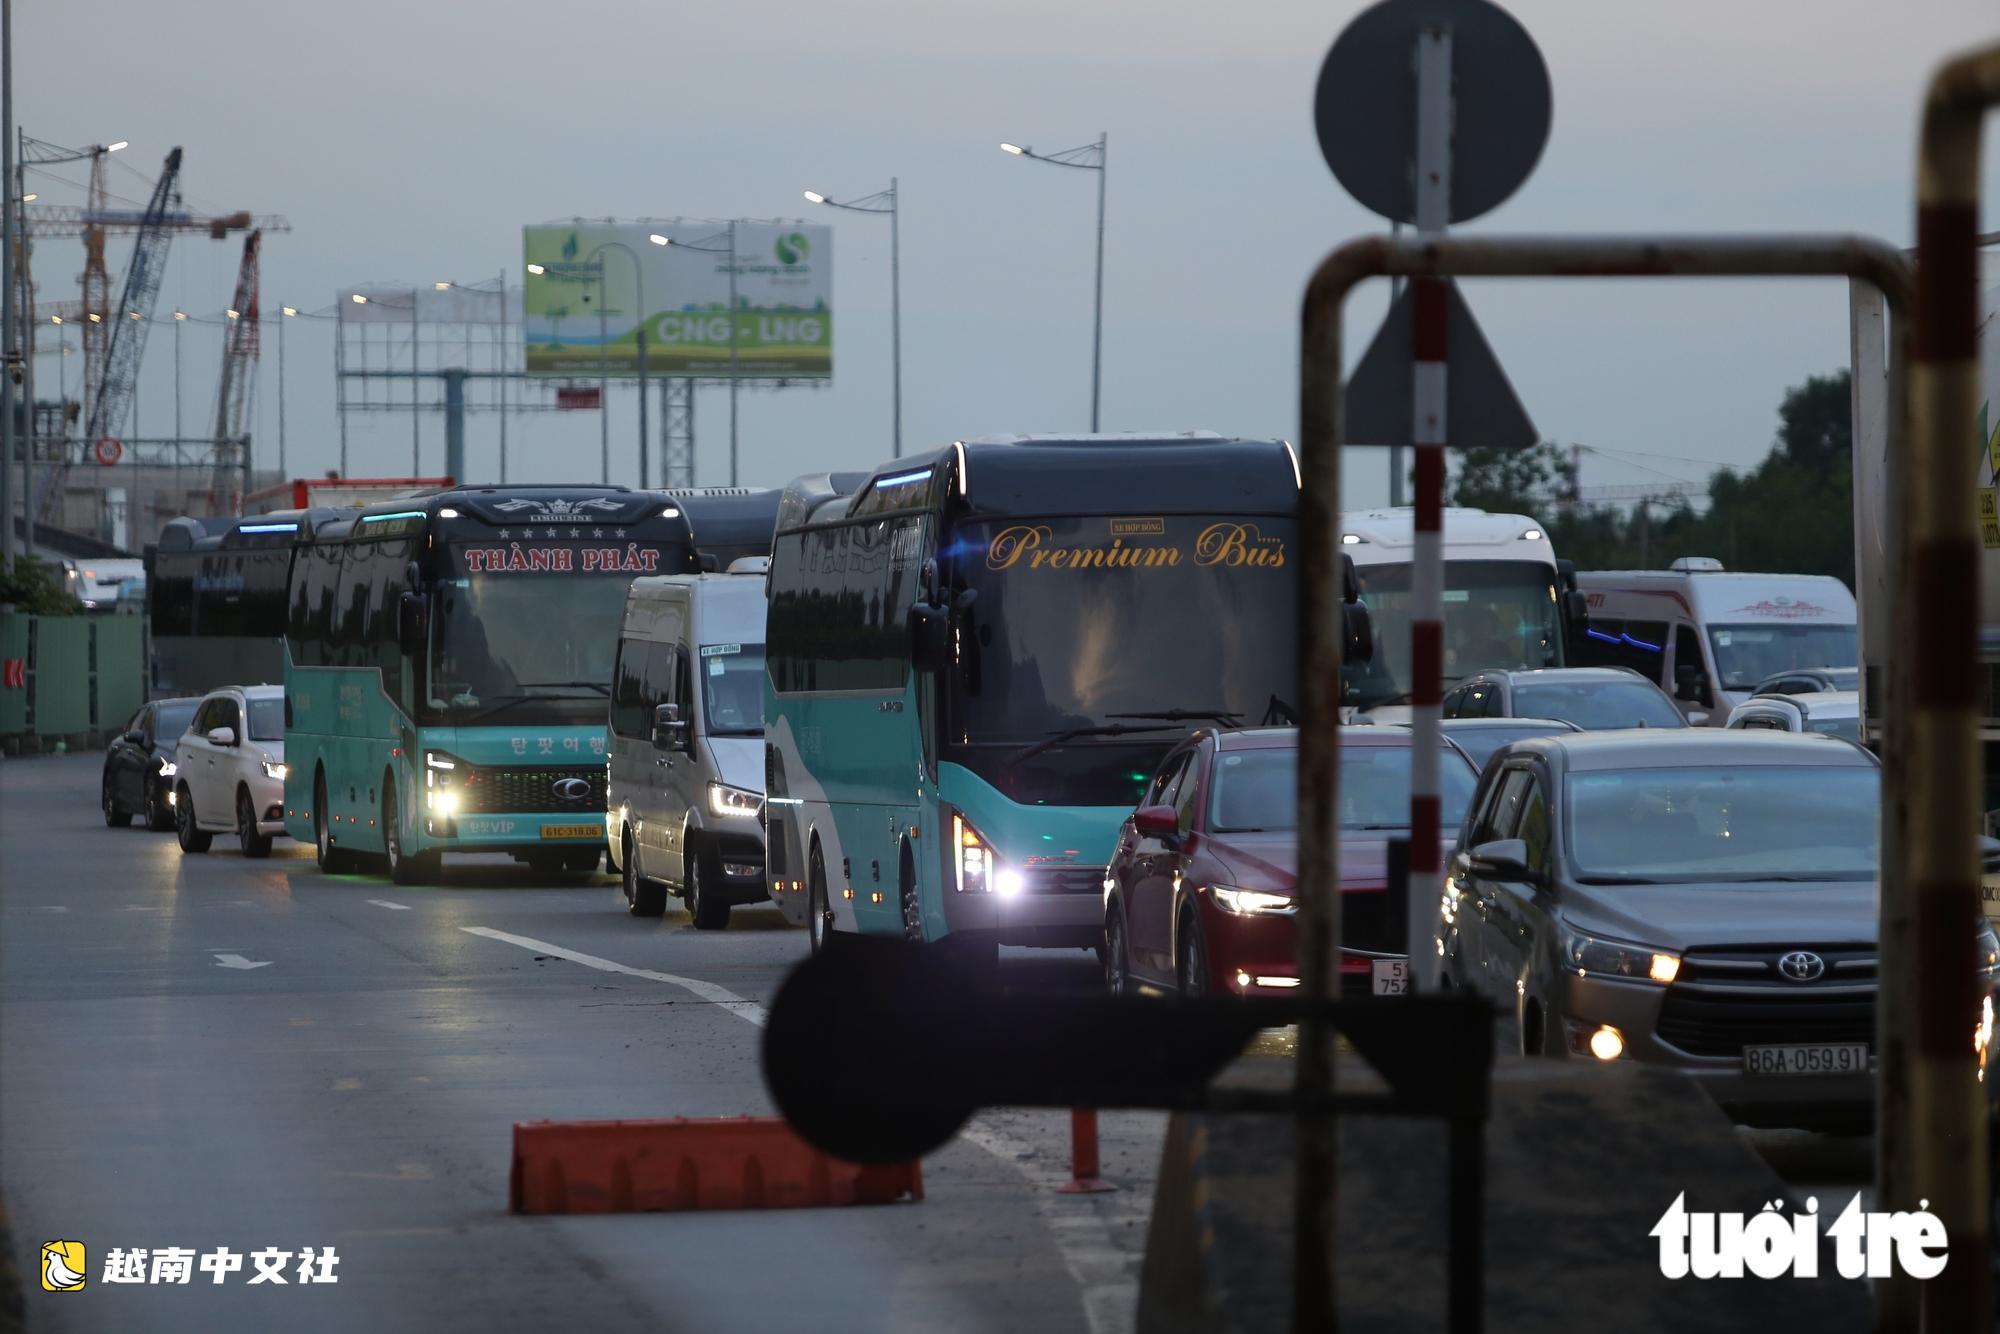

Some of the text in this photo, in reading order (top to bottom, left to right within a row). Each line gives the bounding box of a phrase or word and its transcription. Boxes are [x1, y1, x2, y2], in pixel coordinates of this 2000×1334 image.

[657, 317, 731, 343] CNG
[759, 317, 822, 343] LNG
[529, 514, 592, 522] LIMOUSINE
[465, 542, 660, 572] THÀNH PHÁT
[986, 522, 1285, 571] Premium Bus
